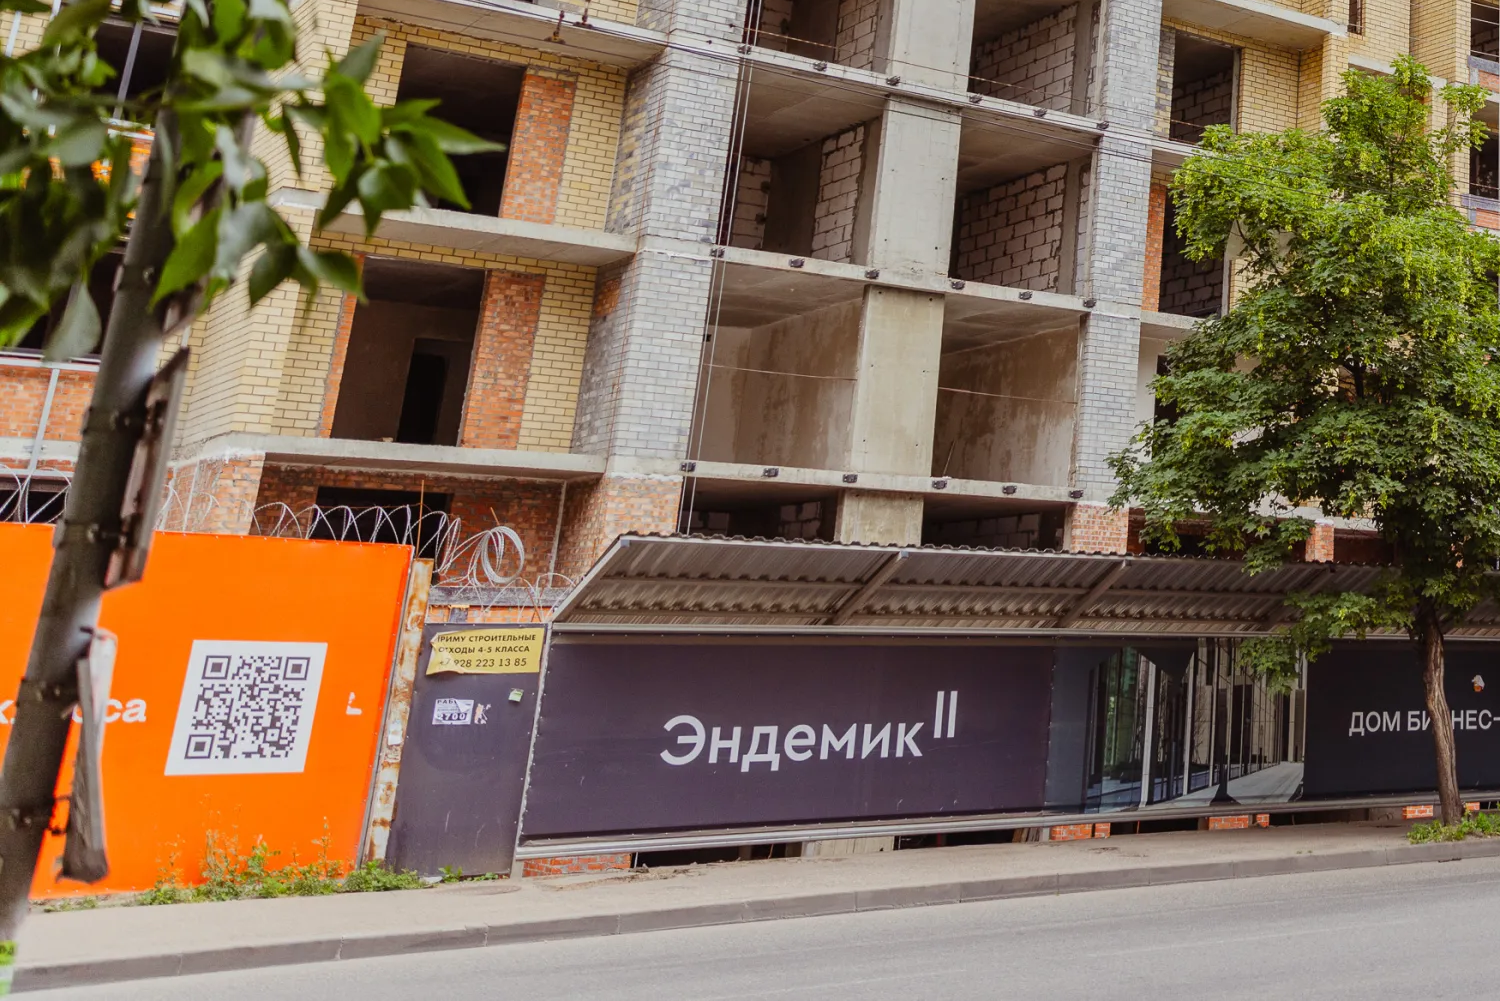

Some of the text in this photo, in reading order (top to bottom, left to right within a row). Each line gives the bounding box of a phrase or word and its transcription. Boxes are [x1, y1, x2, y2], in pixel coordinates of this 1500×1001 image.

[468, 634, 537, 643] СТРОИТЕЛЬНЫЕ
[495, 645, 530, 653] КЛАССА
[453, 659, 472, 667] 928
[476, 659, 495, 667] 223
[499, 658, 511, 666] 13
[514, 658, 527, 666] 85
[1349, 711, 1401, 737] ДОМ
[660, 714, 924, 772] Эндемик
